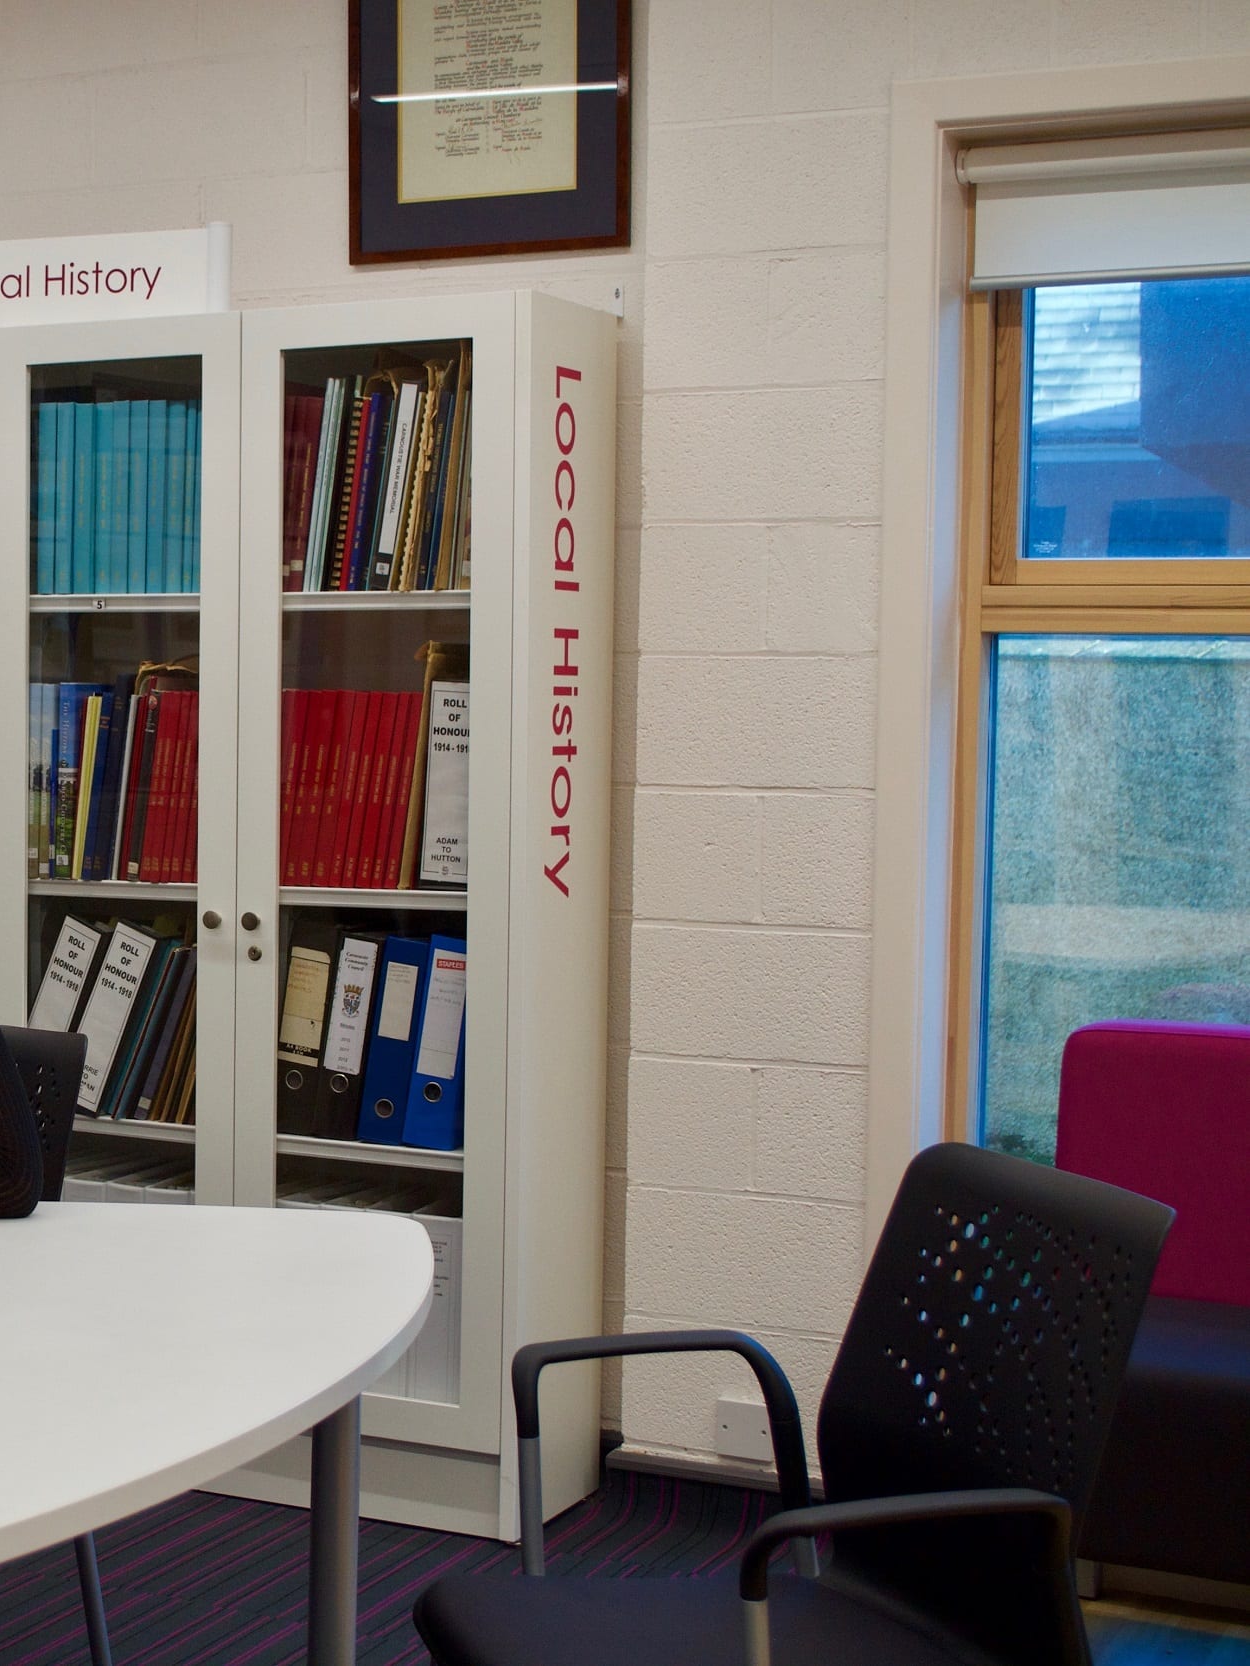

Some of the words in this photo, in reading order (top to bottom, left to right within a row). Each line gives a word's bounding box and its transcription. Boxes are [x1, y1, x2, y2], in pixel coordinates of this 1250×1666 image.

[45, 261, 162, 300] History
[396, 423, 407, 464] CARNOUSTIE
[554, 366, 582, 593] Local
[390, 481, 399, 514] MEMORIAL
[97, 600, 102, 610] 5
[443, 699, 467, 708] ROLL
[448, 713, 461, 722] OF
[544, 628, 579, 898] History
[431, 854, 460, 863] HUTTON
[68, 936, 85, 950] ROLL
[120, 942, 139, 957] ROLL
[68, 950, 78, 960] OF
[121, 957, 132, 966] OF
[54, 956, 84, 978] HONOUR
[105, 963, 137, 984] HONOUR
